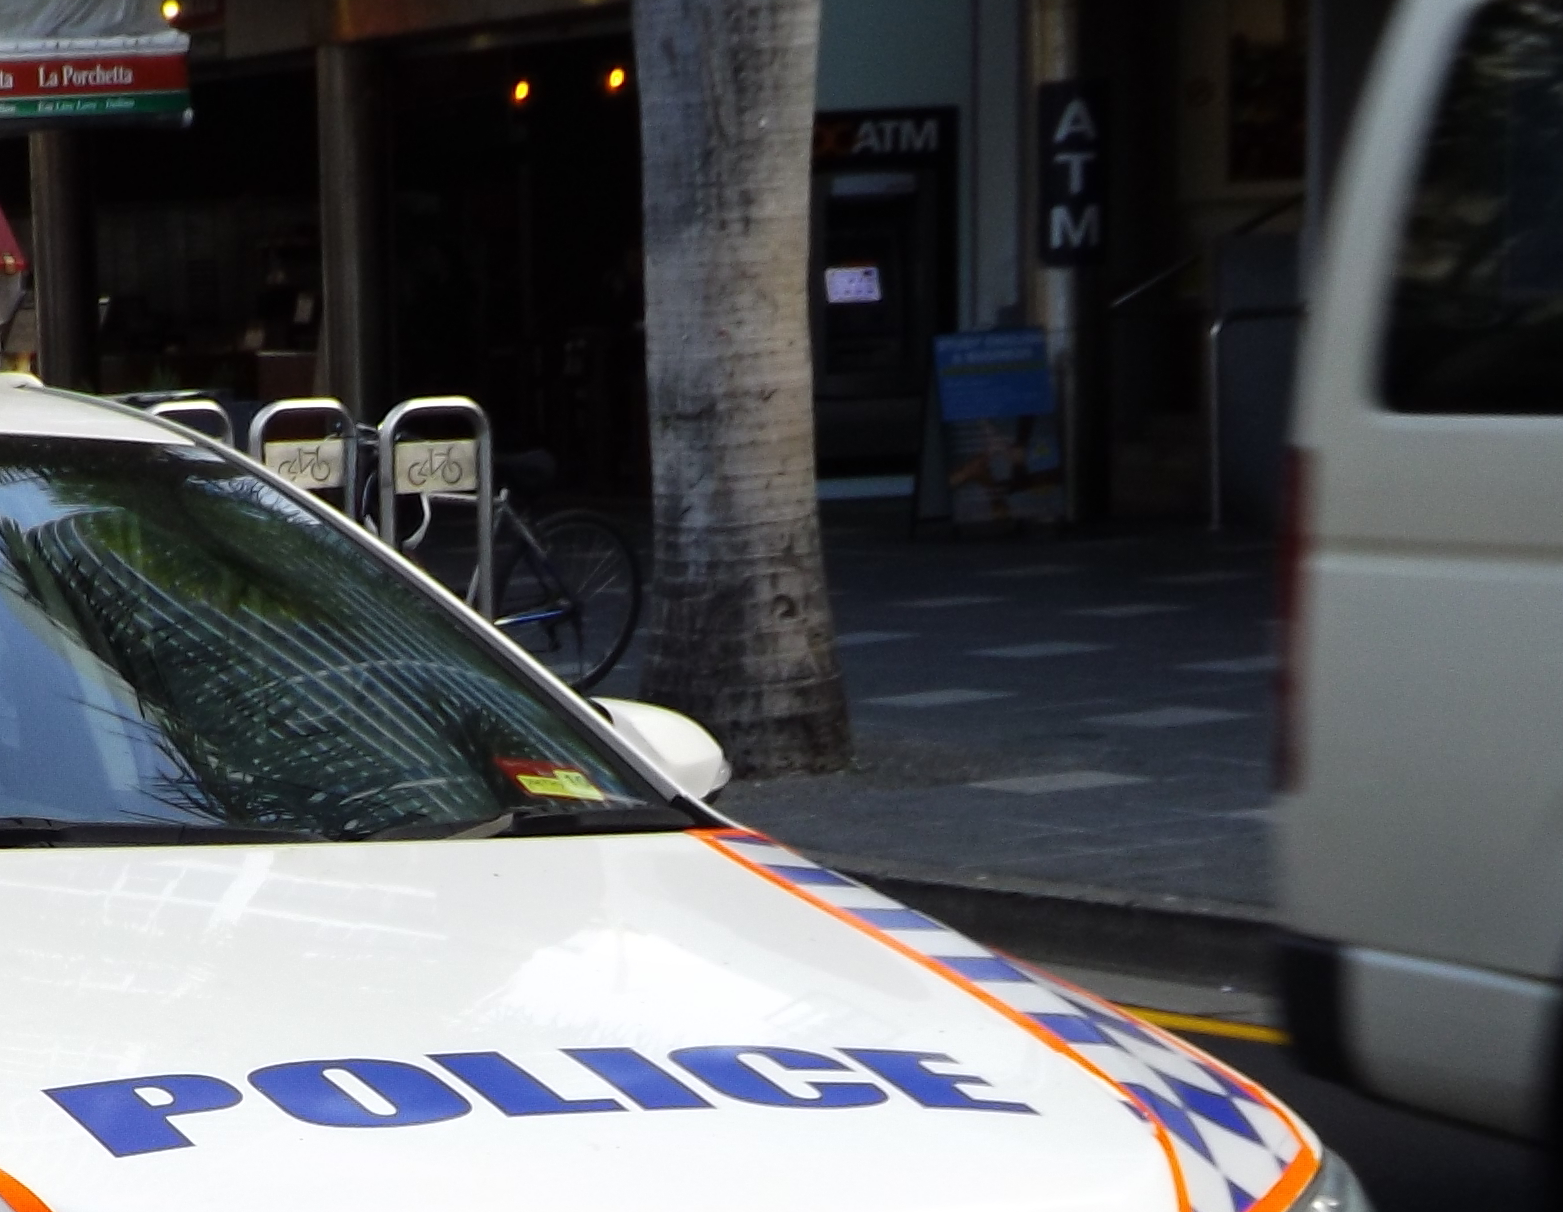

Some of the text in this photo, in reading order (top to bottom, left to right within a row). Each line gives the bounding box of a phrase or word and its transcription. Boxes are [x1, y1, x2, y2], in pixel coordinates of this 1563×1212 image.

[37, 63, 133, 88] La Porchetta
[850, 118, 940, 155] ATM
[1049, 98, 1102, 250] ATM
[39, 1045, 1042, 1158] POLICE
